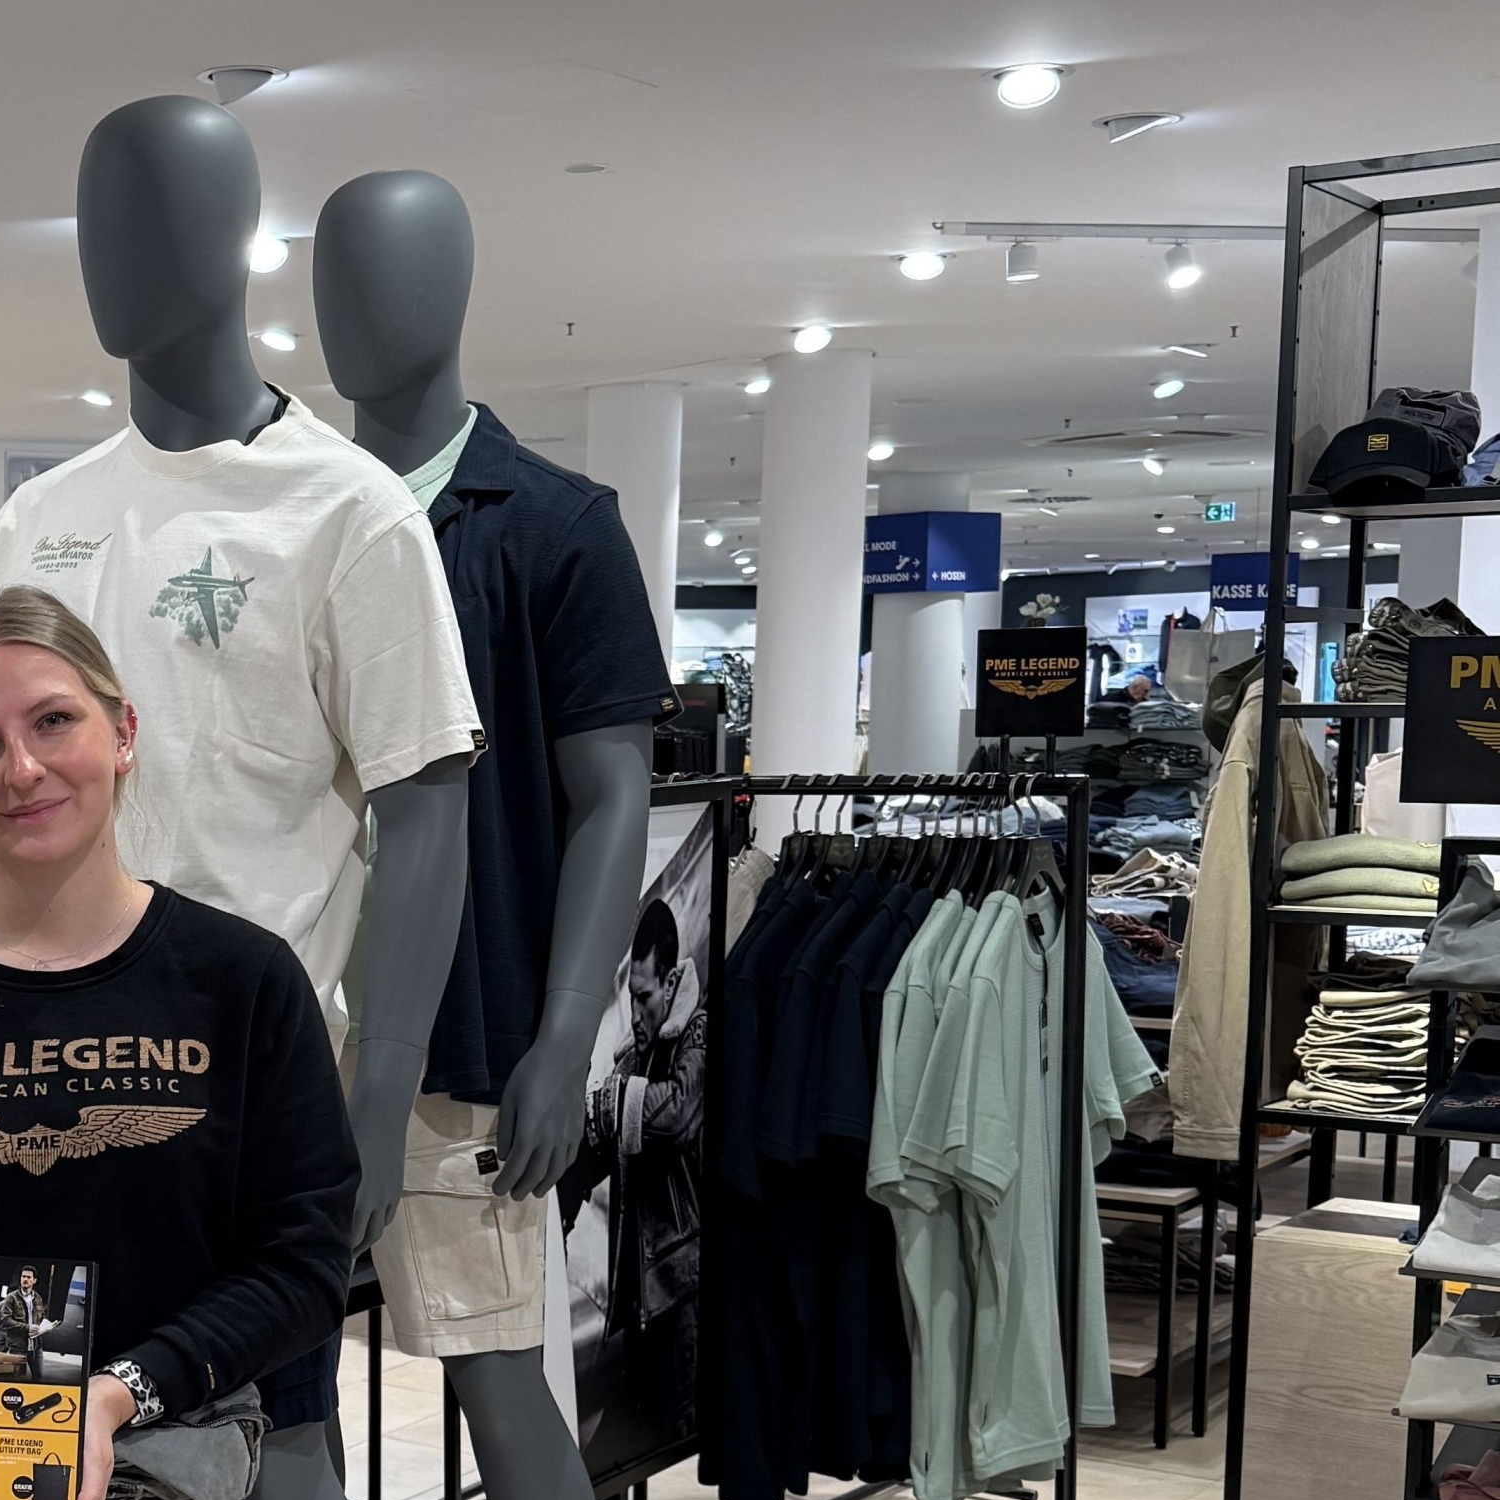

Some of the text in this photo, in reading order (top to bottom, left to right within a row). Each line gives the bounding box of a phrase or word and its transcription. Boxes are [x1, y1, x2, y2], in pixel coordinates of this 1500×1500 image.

[57, 532, 113, 554] Legend
[871, 541, 897, 551] MODE
[59, 551, 93, 561] AVIATOR
[940, 571, 966, 581] HOSEN
[1212, 584, 1253, 599] KASSE
[985, 657, 1080, 671] PME LEGEND
[2, 1035, 211, 1076] LEGEND
[66, 1077, 180, 1093] CLASSIC
[16, 1136, 61, 1150] PME
[0, 1437, 16, 1446] PME
[16, 1438, 43, 1447] LEGEND
